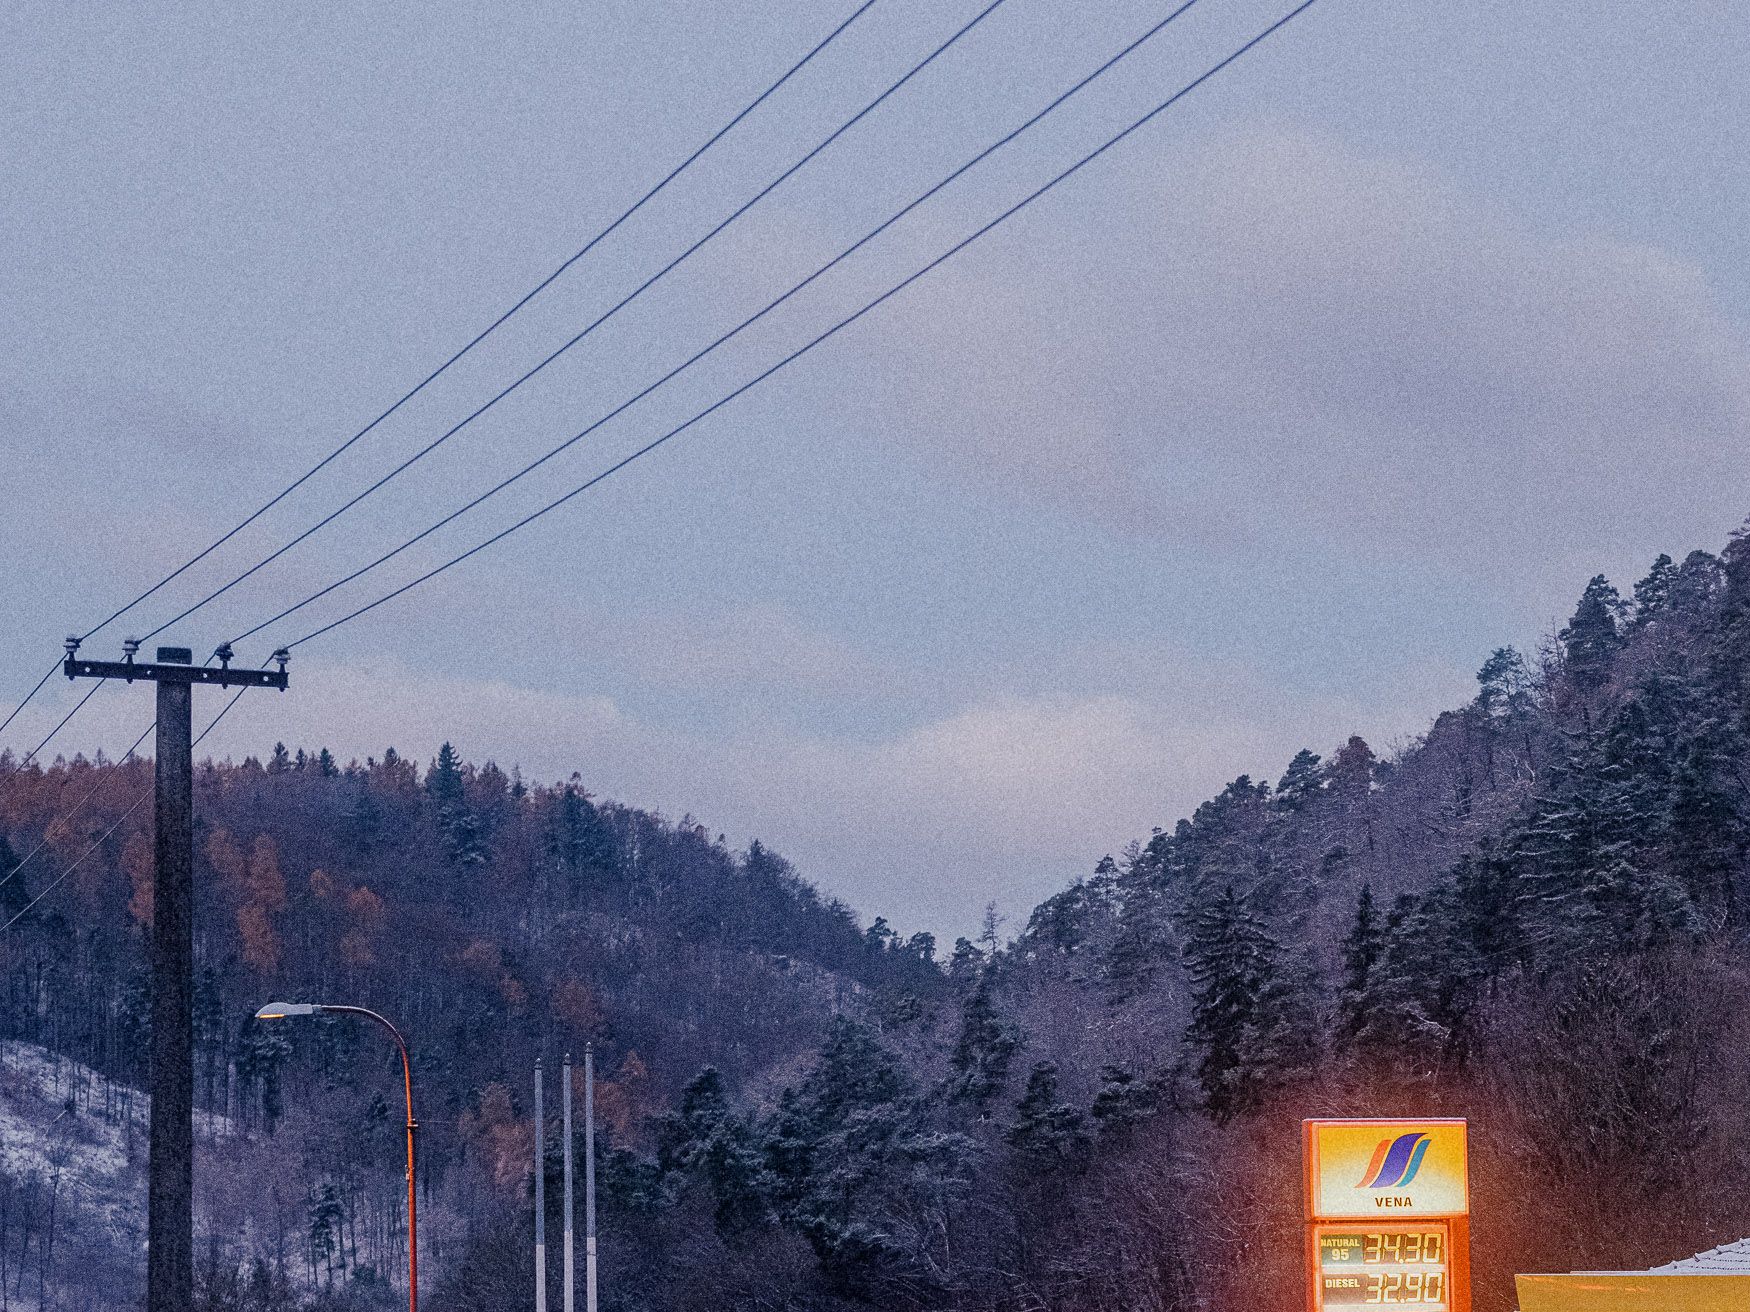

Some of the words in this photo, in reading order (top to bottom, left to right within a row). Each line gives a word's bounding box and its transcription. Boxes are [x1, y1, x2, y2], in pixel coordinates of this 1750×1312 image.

[1375, 1197, 1412, 1207] VENA
[1321, 1239, 1360, 1247] NATURAL
[1365, 1234, 1441, 1263] 34.30
[1332, 1249, 1349, 1260] 95
[1326, 1279, 1360, 1288] DIESEL
[1366, 1273, 1442, 1303] 32.90
